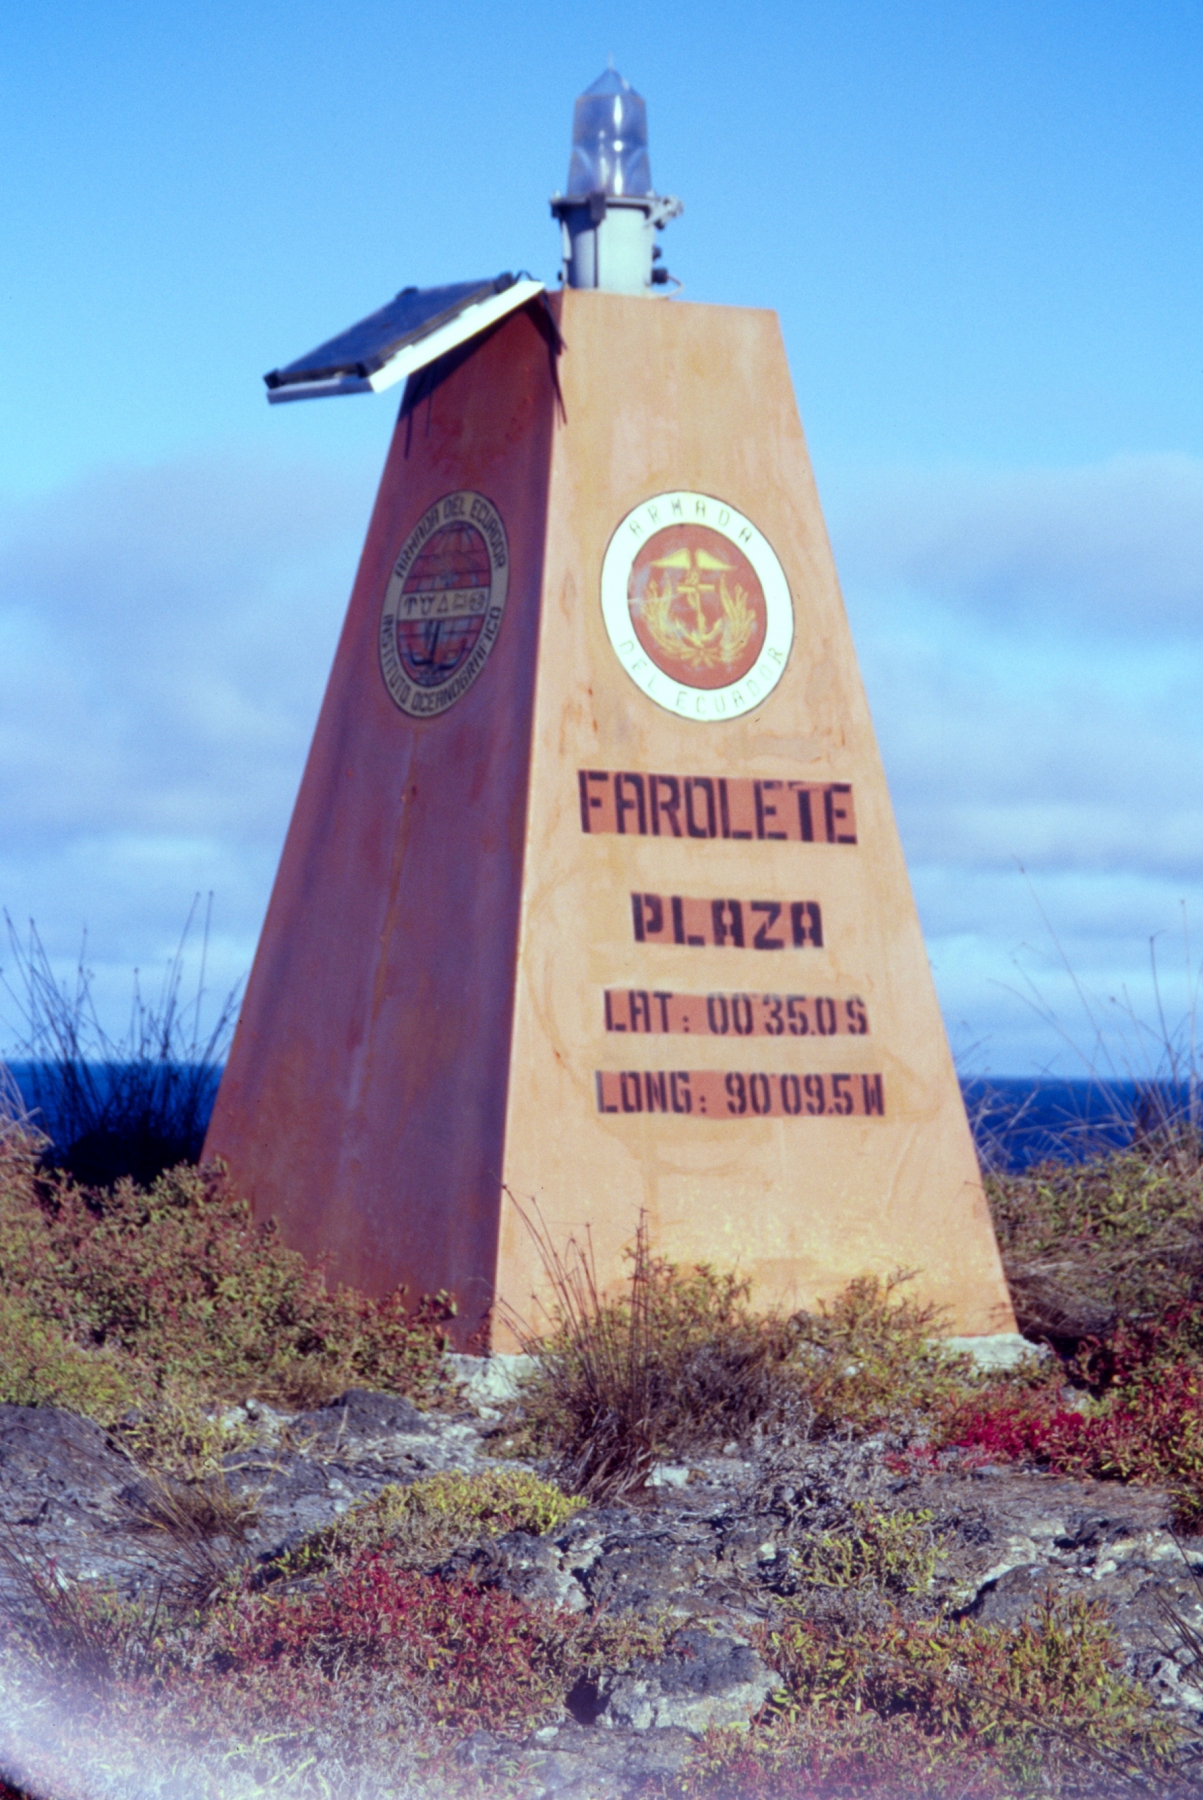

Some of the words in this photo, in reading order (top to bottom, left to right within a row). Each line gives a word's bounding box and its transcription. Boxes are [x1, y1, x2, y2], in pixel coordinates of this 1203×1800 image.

[628, 498, 753, 545] ARMADA
[619, 639, 659, 693] DEL
[675, 646, 784, 715] ECUADOR
[577, 769, 858, 845] FAROLETE
[630, 892, 824, 950] PLAZA
